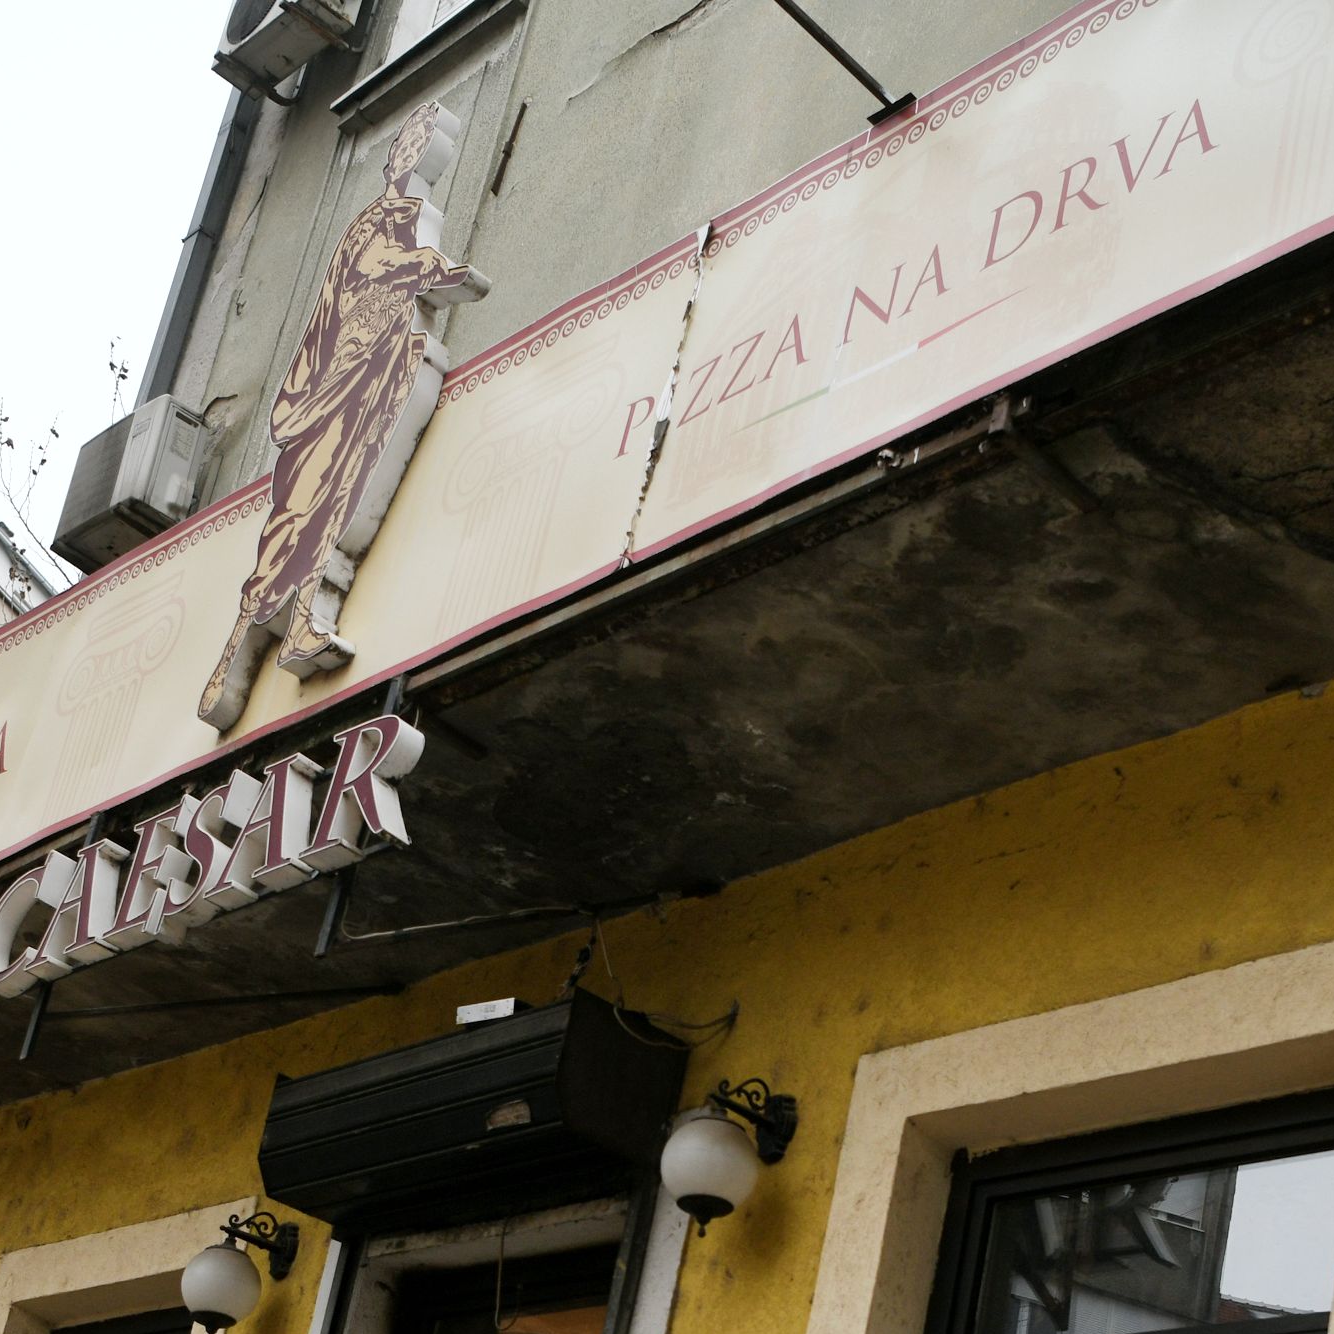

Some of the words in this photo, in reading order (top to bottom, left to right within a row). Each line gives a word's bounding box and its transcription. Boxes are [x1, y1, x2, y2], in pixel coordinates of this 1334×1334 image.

[612, 313, 810, 461] PZZA
[841, 243, 949, 346] NA
[980, 97, 1220, 272] DRVA
